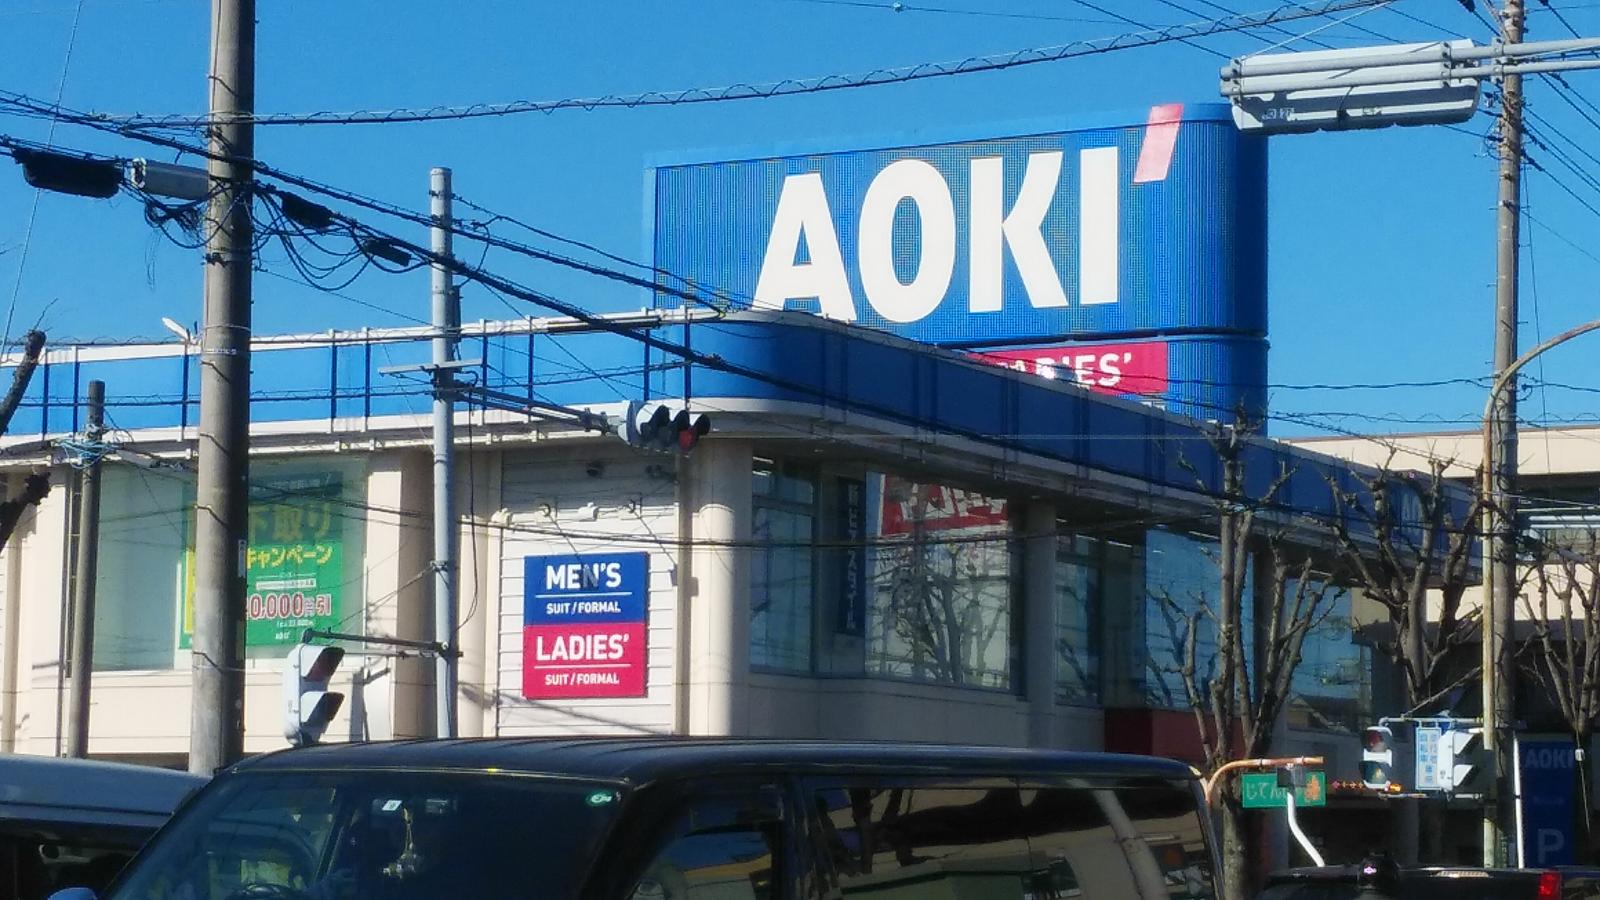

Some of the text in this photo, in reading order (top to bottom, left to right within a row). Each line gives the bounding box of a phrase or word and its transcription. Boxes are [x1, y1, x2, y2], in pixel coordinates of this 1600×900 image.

[546, 562, 622, 590] MEN'S
[535, 633, 630, 662] LADIES'
[1537, 828, 1565, 864] P
